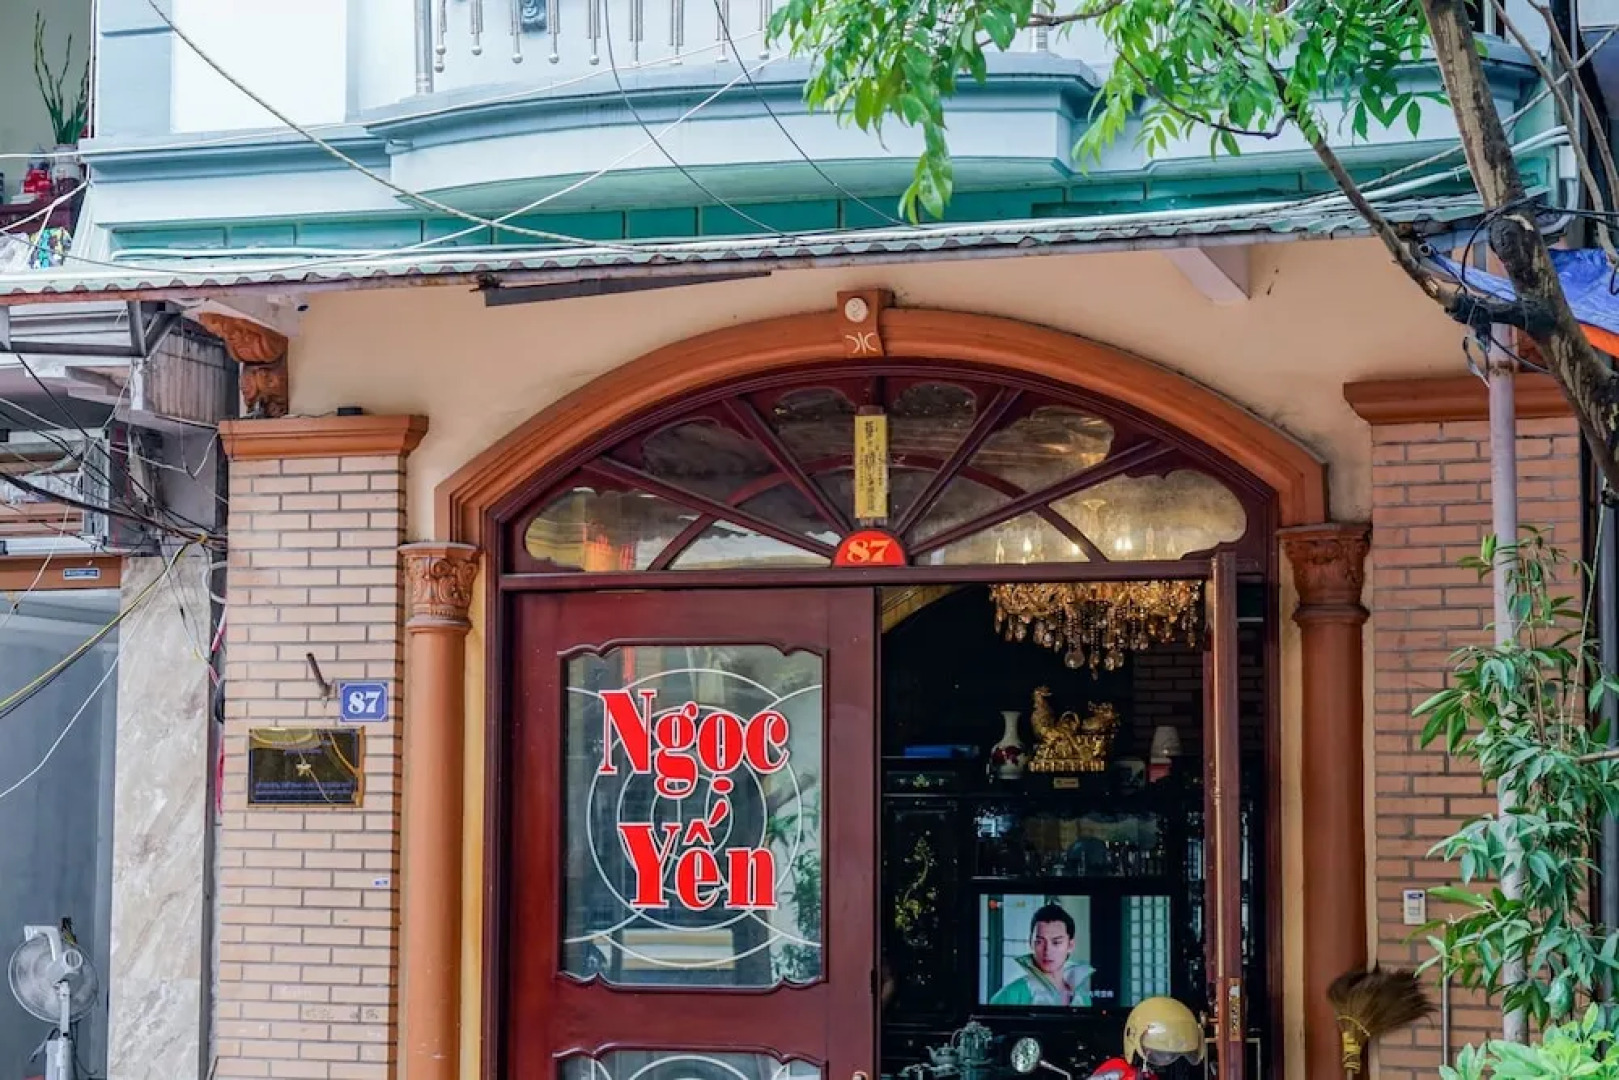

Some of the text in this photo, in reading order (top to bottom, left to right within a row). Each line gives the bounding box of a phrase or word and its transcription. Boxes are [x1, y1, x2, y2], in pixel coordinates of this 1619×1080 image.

[846, 540, 890, 563] 87
[348, 691, 382, 714] 87
[599, 688, 790, 799] Ngọc
[617, 798, 778, 911] Yến
